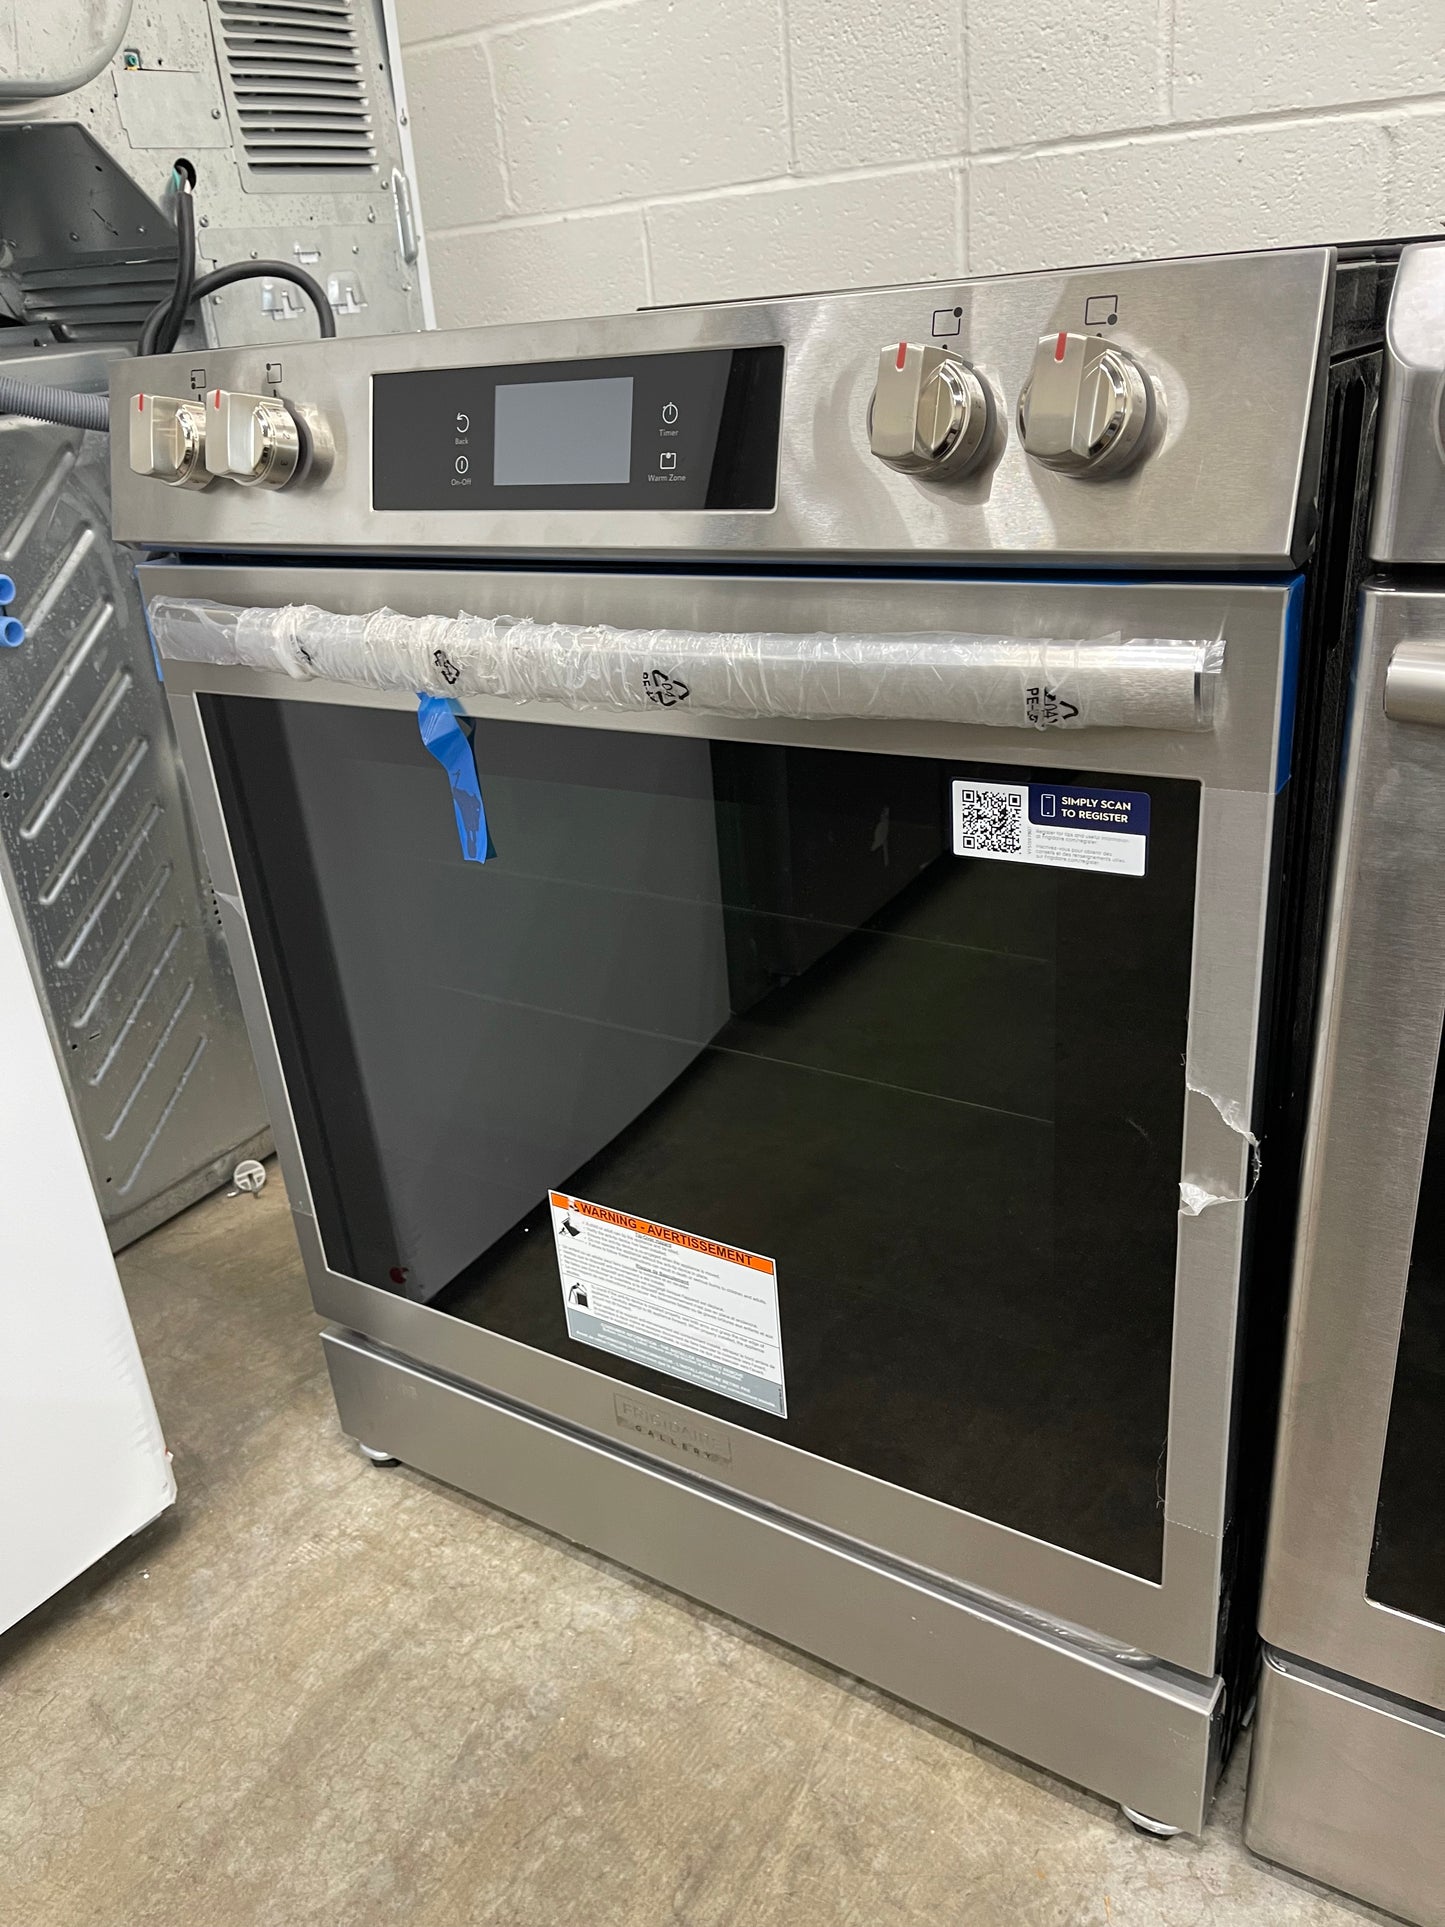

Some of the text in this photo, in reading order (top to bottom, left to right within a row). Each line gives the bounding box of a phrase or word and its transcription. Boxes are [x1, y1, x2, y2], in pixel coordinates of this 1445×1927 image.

[455, 437, 469, 445] Back
[648, 473, 687, 482] Warm Zone
[1061, 796, 1132, 811] SIMPLY SCAN
[1061, 808, 1128, 823] TO REGISTER
[581, 1203, 637, 1229] WARNING
[647, 1225, 753, 1266] AVERTISSEMENT
[635, 1425, 711, 1458] GALLERY
